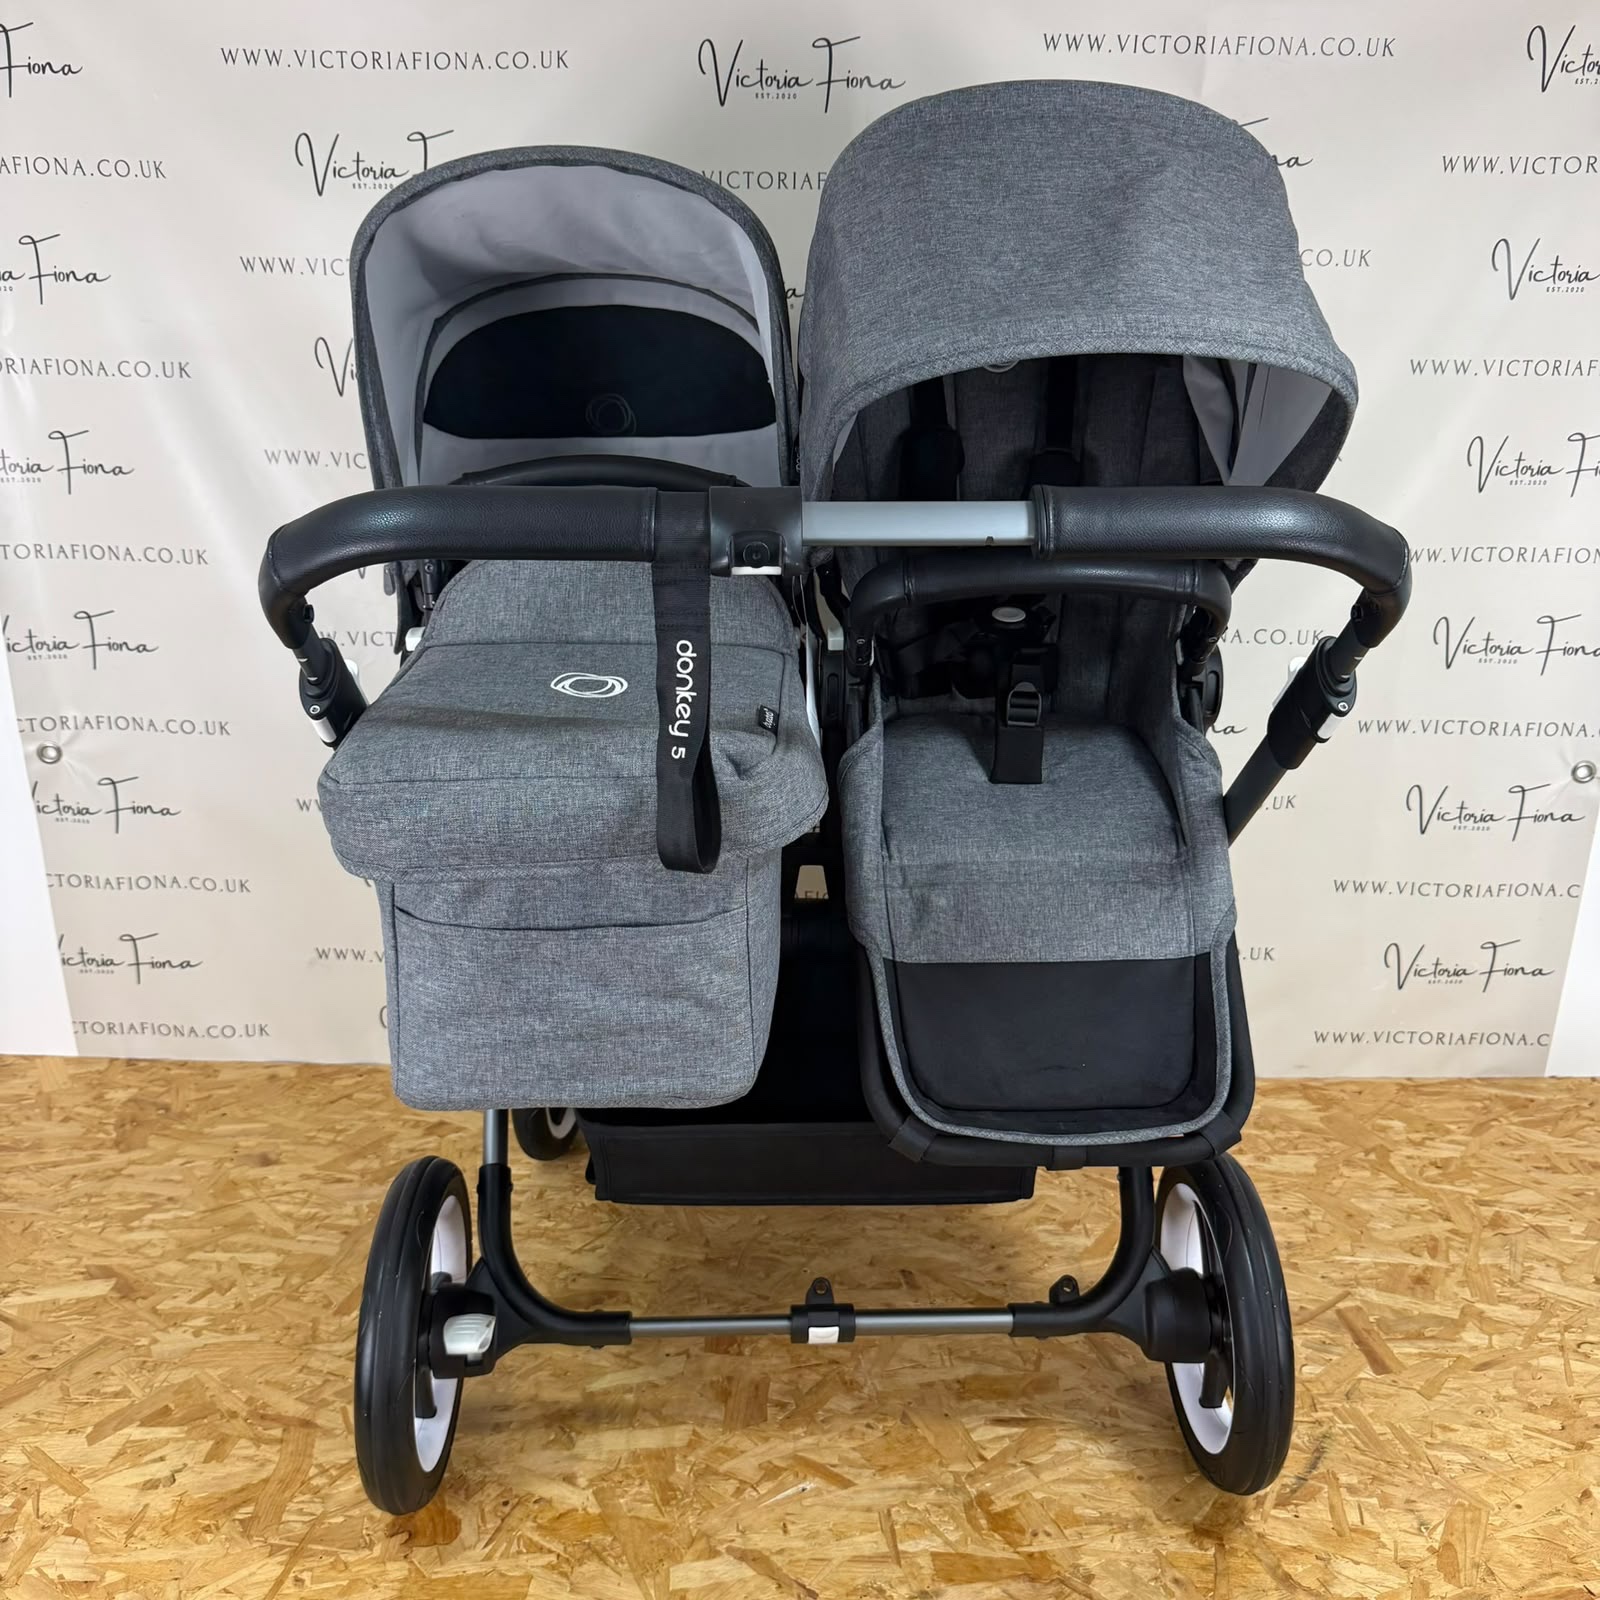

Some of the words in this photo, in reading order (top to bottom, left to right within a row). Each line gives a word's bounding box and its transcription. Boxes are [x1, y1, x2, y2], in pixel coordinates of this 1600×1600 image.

[220, 47, 568, 71] WWW.VICTORIAFIONA.CO.UK
[1044, 34, 1396, 57] WWW.VICTORIAFIONA.CO.UK
[1526, 24, 1600, 93] Victor
[698, 38, 814, 107] Victoria
[812, 36, 906, 113] Fiona
[755, 92, 797, 100] EST.2020
[0, 156, 166, 179] AFIONA.CO.UK
[295, 132, 409, 196] Victoria
[1442, 155, 1598, 175] WWW.VICTOR
[19, 234, 111, 304] Fiona
[1491, 238, 1600, 300] Victoria
[0, 357, 192, 379] RIAFIONA.CO.UK
[1410, 359, 1600, 378] WWW.VICTORIAF
[0, 448, 54, 473] toria
[48, 430, 134, 494] Fiona
[1467, 435, 1564, 493] Victoria
[0, 544, 209, 565] TORIAFIONA.CO.UK
[74, 610, 159, 670] Fiona
[1433, 616, 1534, 670] Victoria
[669, 639, 697, 738] donkey
[671, 746, 686, 760] 5
[1358, 719, 1600, 738] WWW.VICTORIAFIONA.
[97, 776, 181, 834] Fiona
[1406, 784, 1505, 835] Victoria
[1507, 784, 1585, 842] Fiona
[1333, 879, 1580, 899] WWW.VICTORIAFIONA.C
[119, 933, 203, 985] Fiona
[1384, 943, 1478, 990] Victoria
[1479, 940, 1555, 993] Fiona
[1314, 1031, 1549, 1048] WWW.VICTORIAFIONA.C
